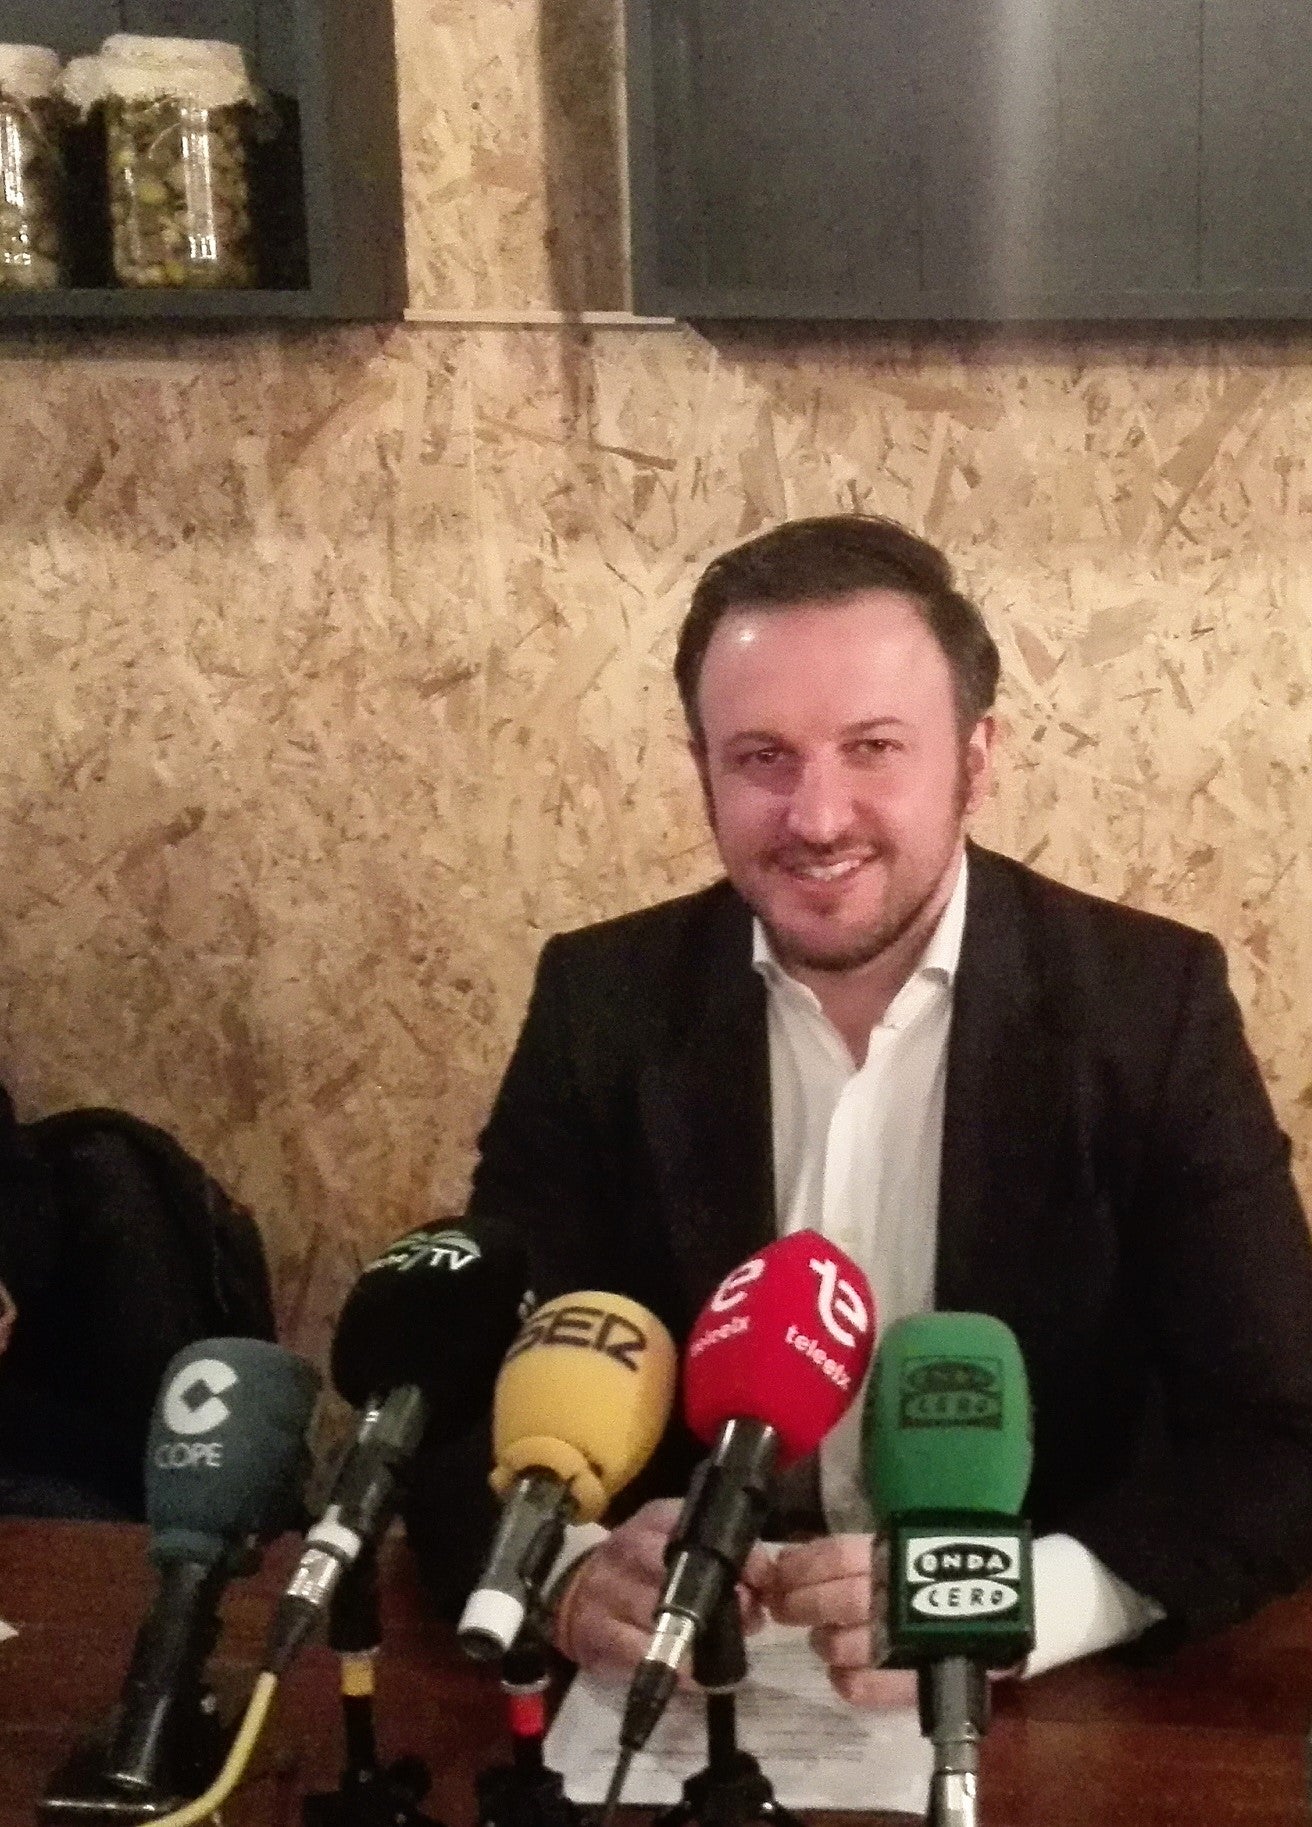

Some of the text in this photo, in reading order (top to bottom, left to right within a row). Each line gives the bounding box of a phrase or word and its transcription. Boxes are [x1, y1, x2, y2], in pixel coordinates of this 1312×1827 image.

[505, 1306, 647, 1371] SER
[154, 1442, 224, 1469] COPE
[921, 1554, 1004, 1572] ONDA
[927, 1587, 1004, 1608] CERO
